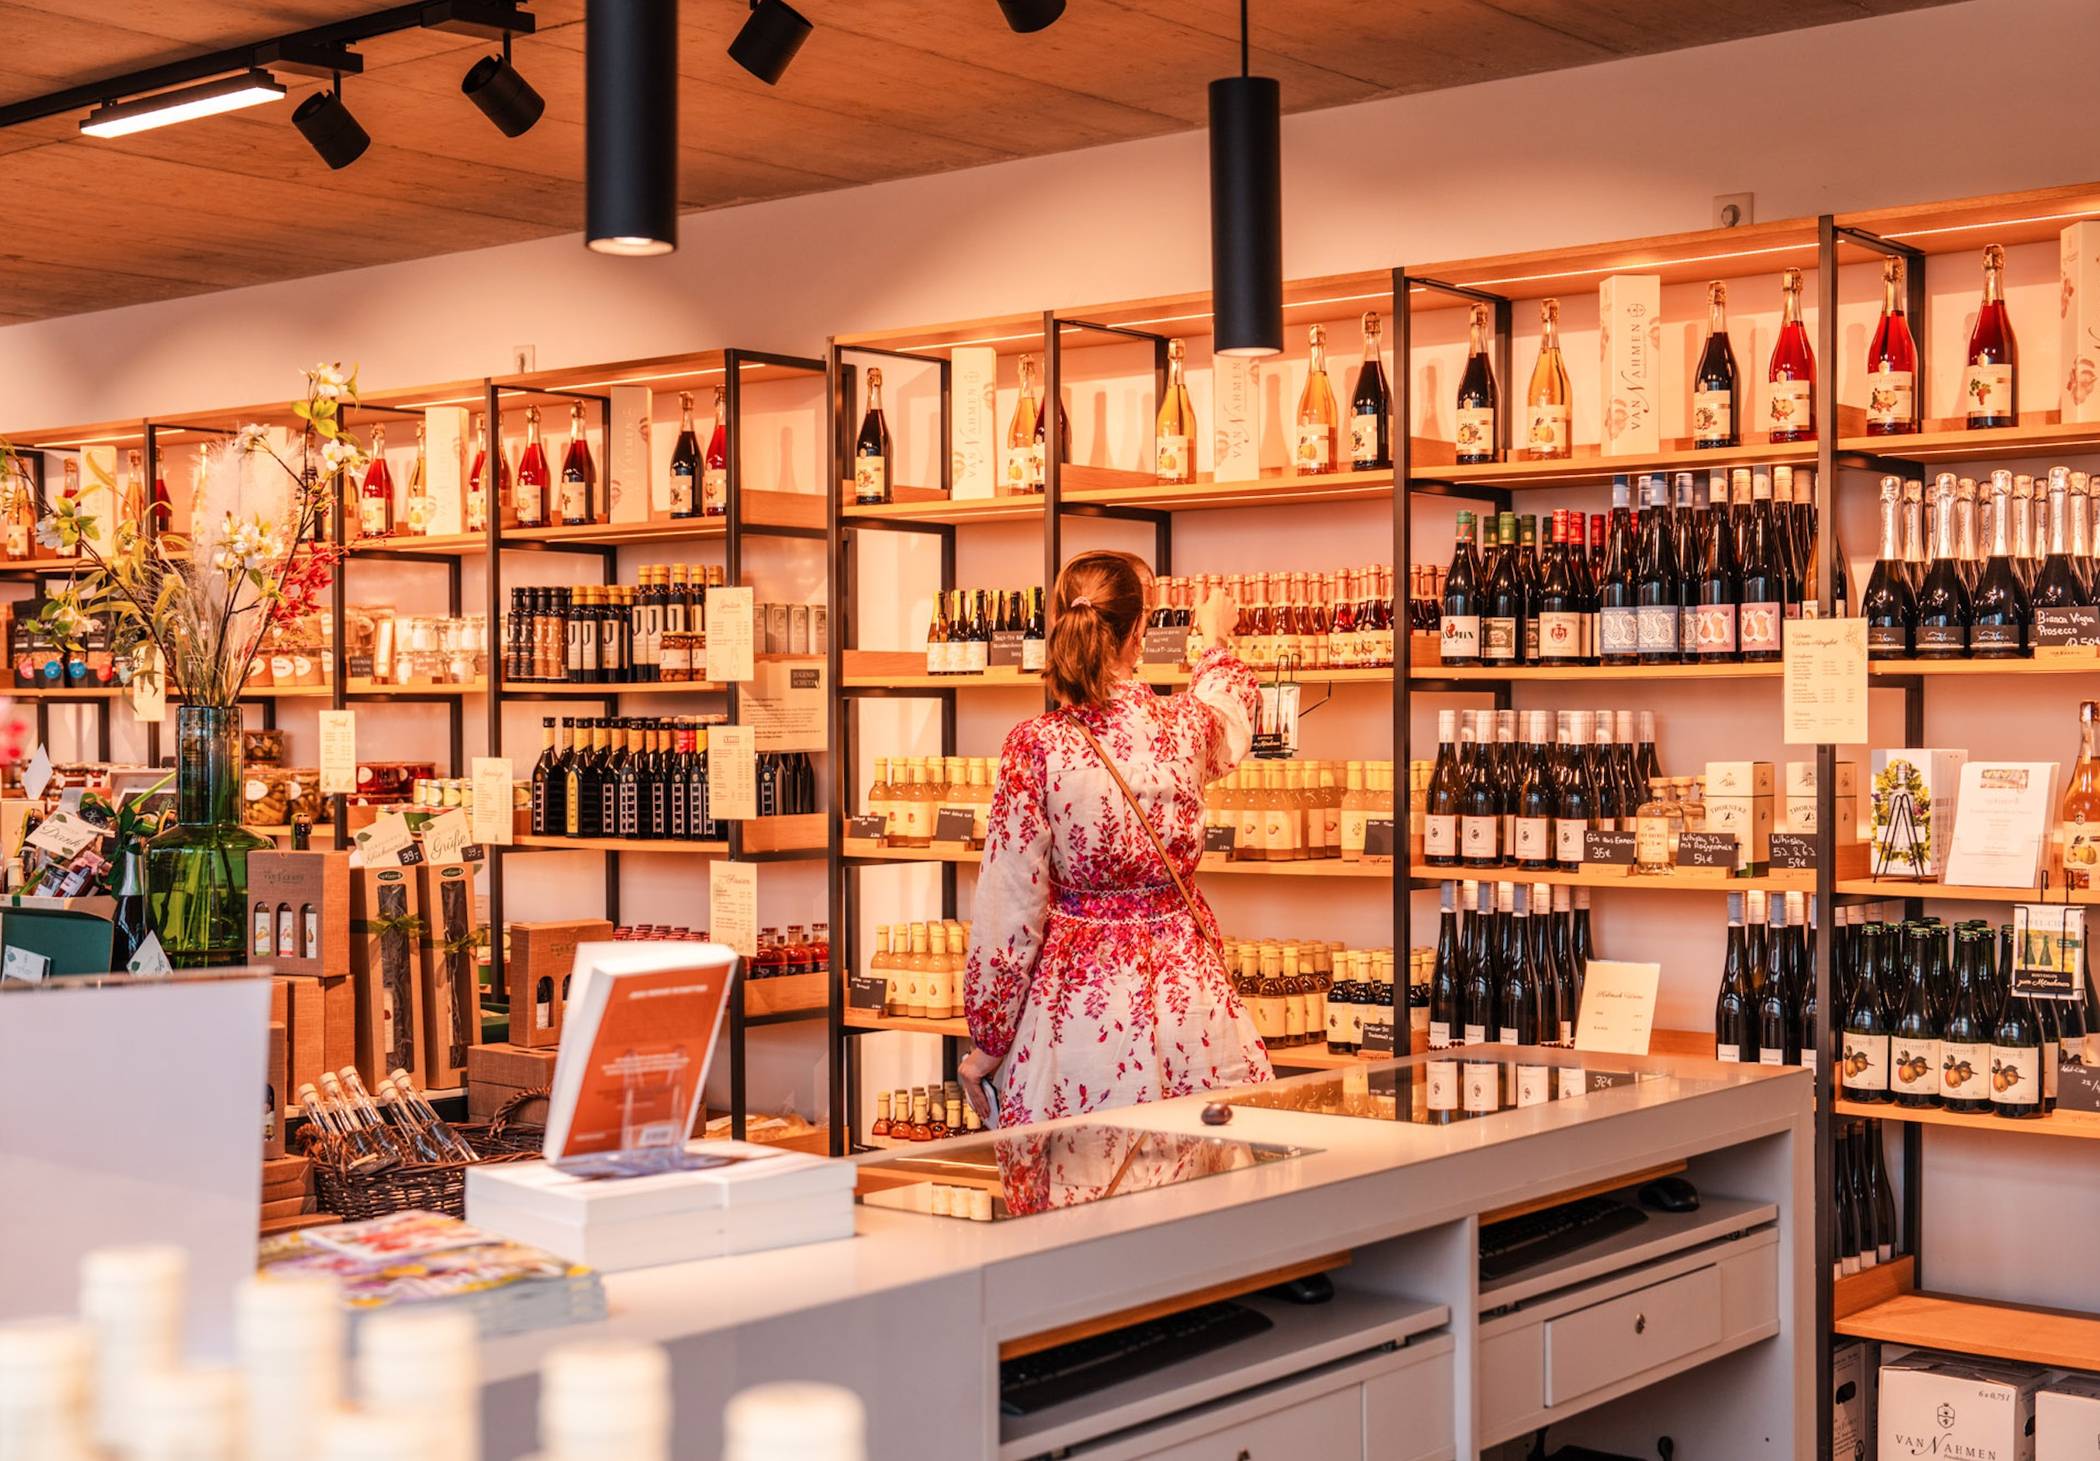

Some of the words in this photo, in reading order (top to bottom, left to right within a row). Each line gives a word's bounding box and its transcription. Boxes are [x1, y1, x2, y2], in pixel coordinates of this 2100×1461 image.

[1620, 323, 1650, 413] NAHMEN
[1620, 400, 1631, 430] VAN
[2036, 610, 2068, 625] Bianca
[2069, 610, 2095, 626] Vigna
[2036, 625, 2078, 637] Prosecco
[42, 824, 85, 847] Dank
[1586, 833, 1600, 843] Gin
[1771, 834, 1807, 849] Whisky
[1592, 846, 1612, 859] 35€
[1787, 857, 1806, 869] 59€
[1896, 1434, 1925, 1448] VAN
[1911, 1432, 1997, 1461] NAHMEN
